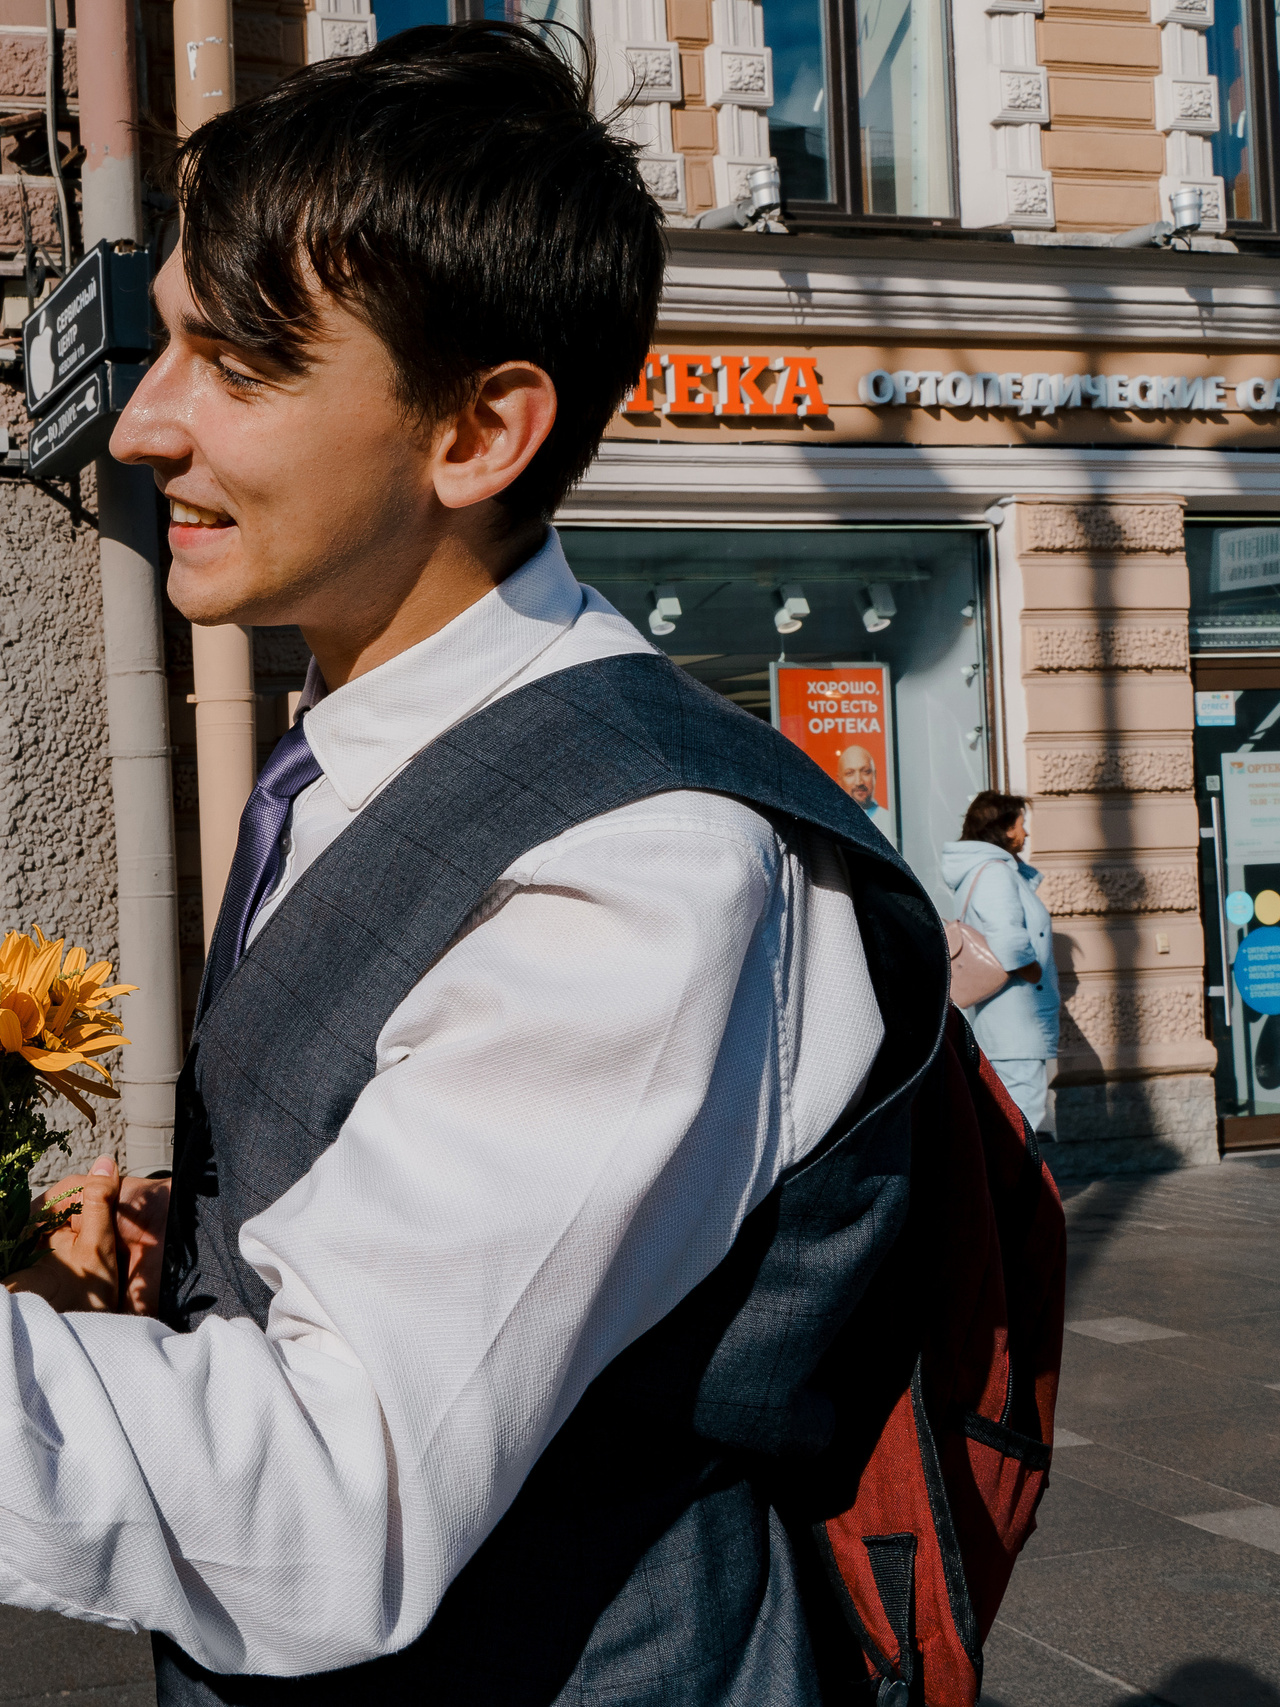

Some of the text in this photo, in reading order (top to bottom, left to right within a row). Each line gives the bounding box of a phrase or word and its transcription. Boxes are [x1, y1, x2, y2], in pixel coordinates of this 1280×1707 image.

[56, 276, 96, 333] СЕРВИСНЫЙ
[57, 323, 78, 357] ЦЕНТР
[859, 369, 1227, 416] ОРТОПЕДИЧЕСКИЕ
[47, 402, 78, 443] ВО ДВОРЕ
[806, 681, 880, 696] ХОРОШО,
[807, 700, 878, 714] ЧТО ЕСТЬ
[808, 717, 881, 734] ОРТЕКА
